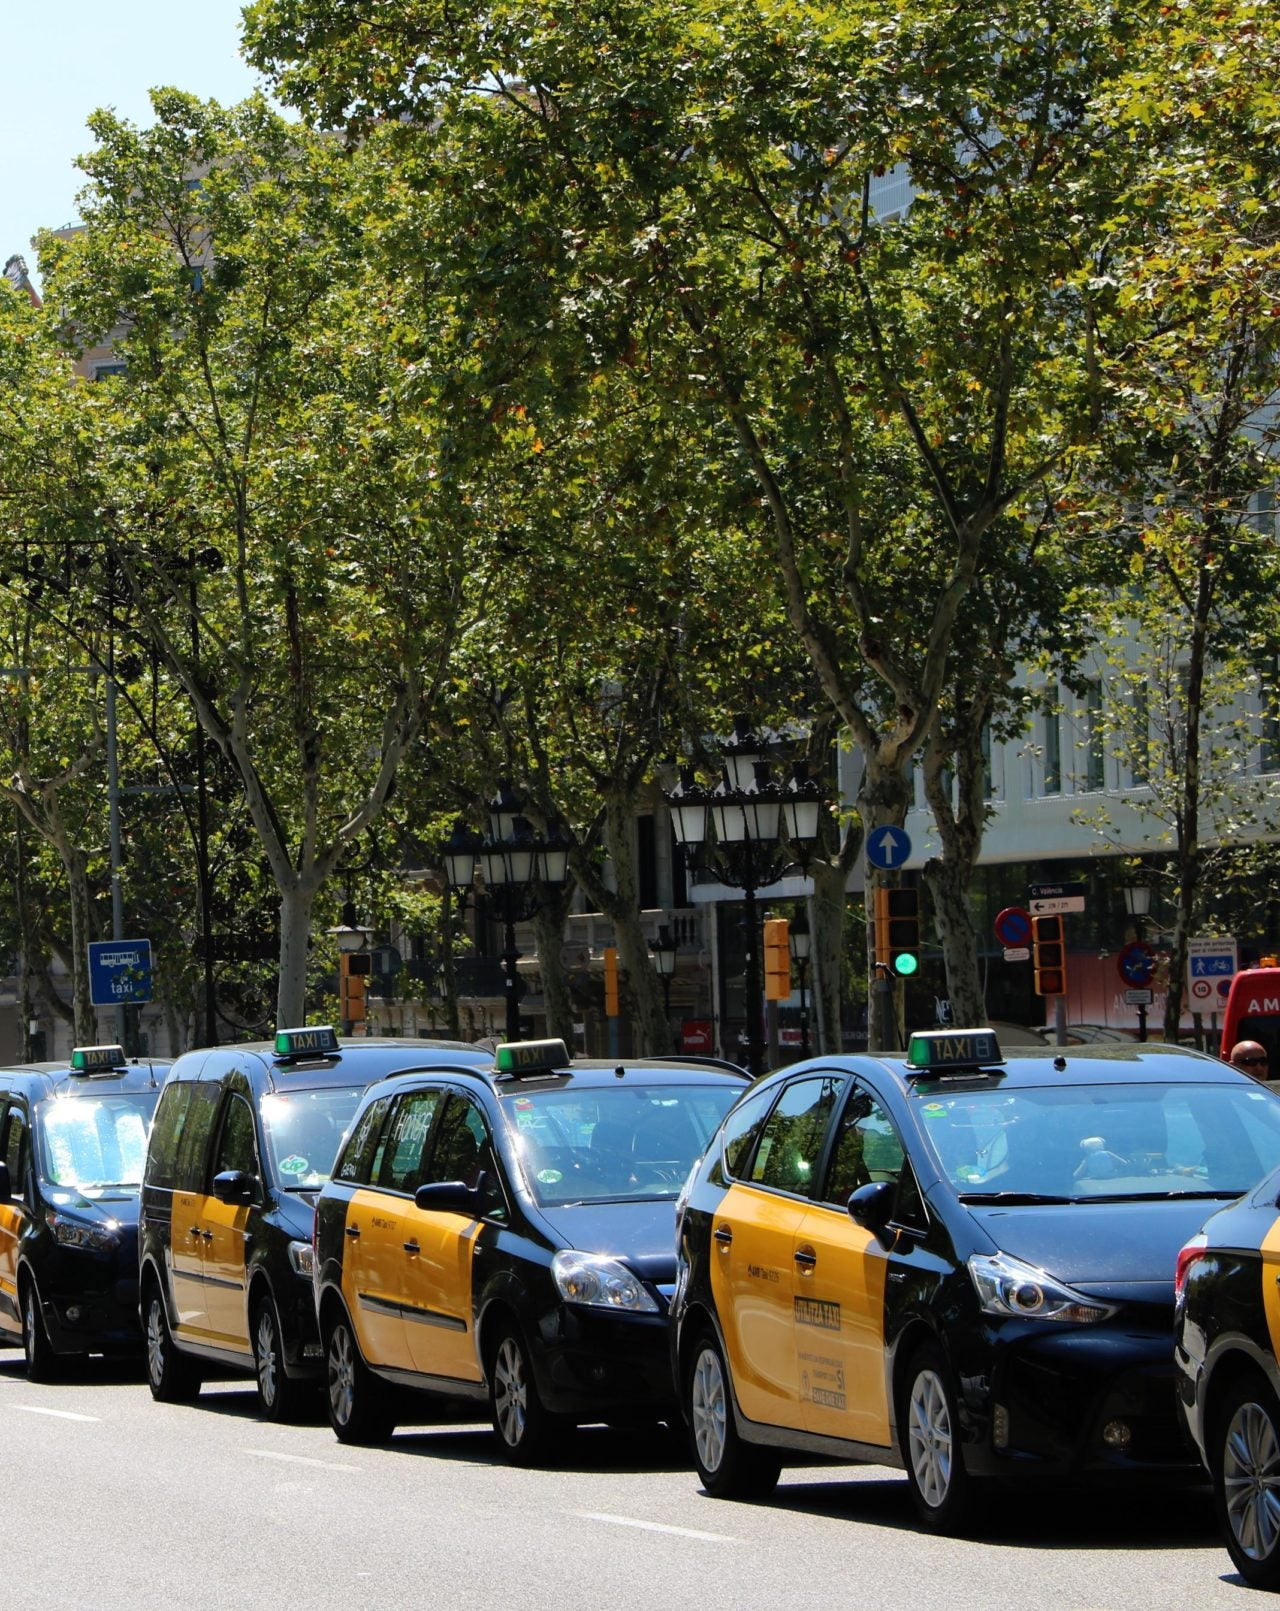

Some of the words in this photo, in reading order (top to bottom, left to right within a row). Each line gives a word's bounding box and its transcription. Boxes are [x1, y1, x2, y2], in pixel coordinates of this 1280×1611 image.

[111, 981, 133, 994] taxi
[291, 1032, 318, 1049] TAXI
[933, 1038, 972, 1060] TAXI
[86, 1050, 109, 1065] TAXI
[517, 1048, 545, 1065] TAXI
